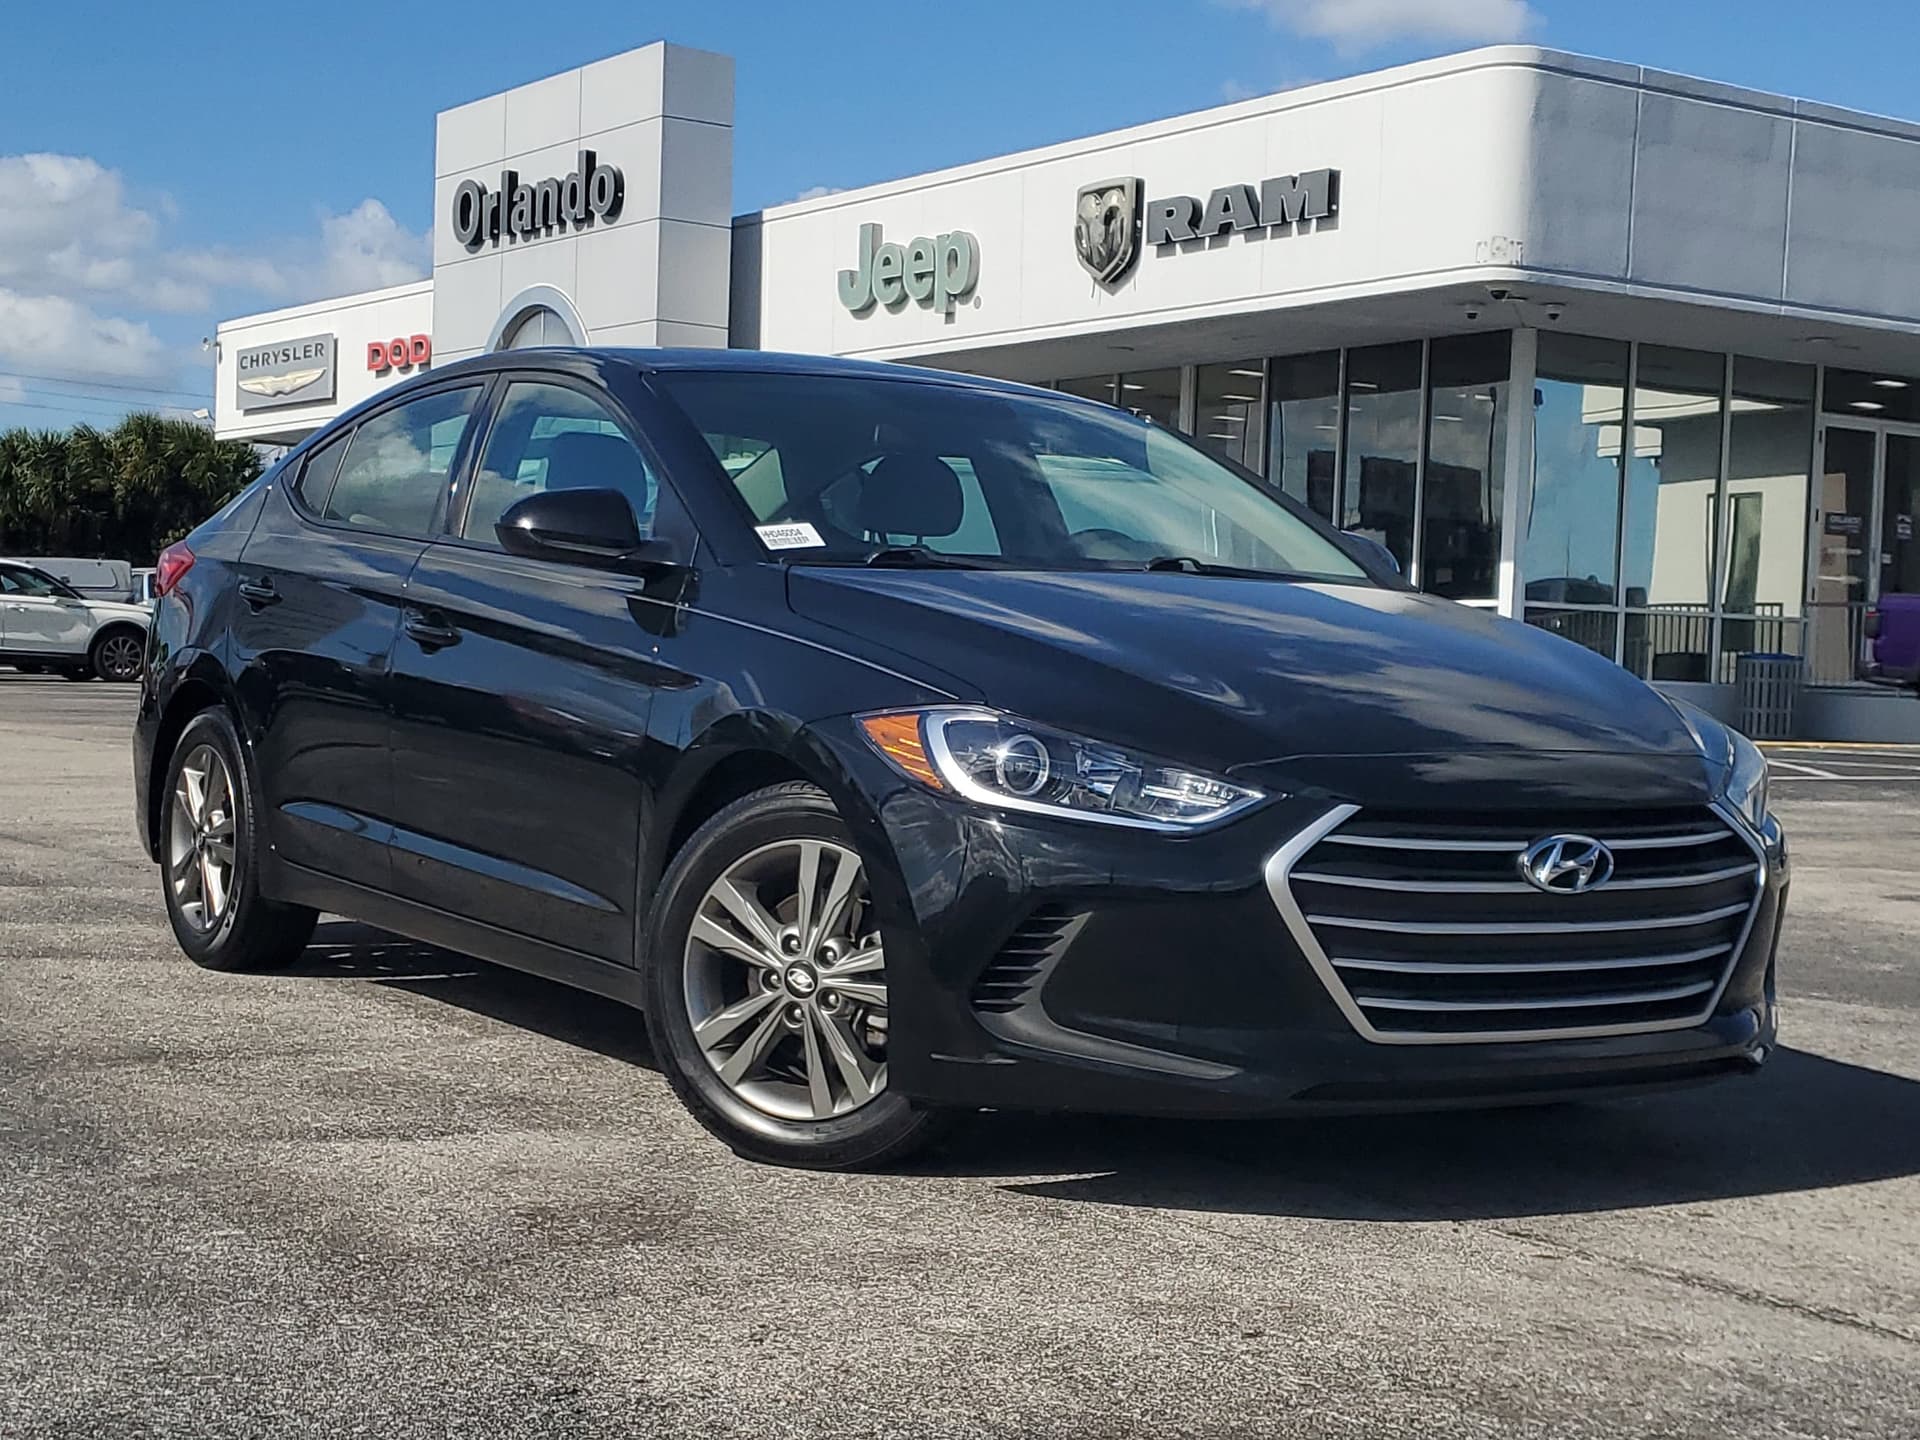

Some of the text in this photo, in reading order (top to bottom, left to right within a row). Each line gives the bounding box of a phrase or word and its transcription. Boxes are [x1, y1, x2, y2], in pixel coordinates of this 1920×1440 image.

[452, 150, 625, 252] Orlando
[1146, 168, 1341, 250] RAM
[837, 222, 980, 318] Jeep
[240, 342, 325, 369] CHRYSLER
